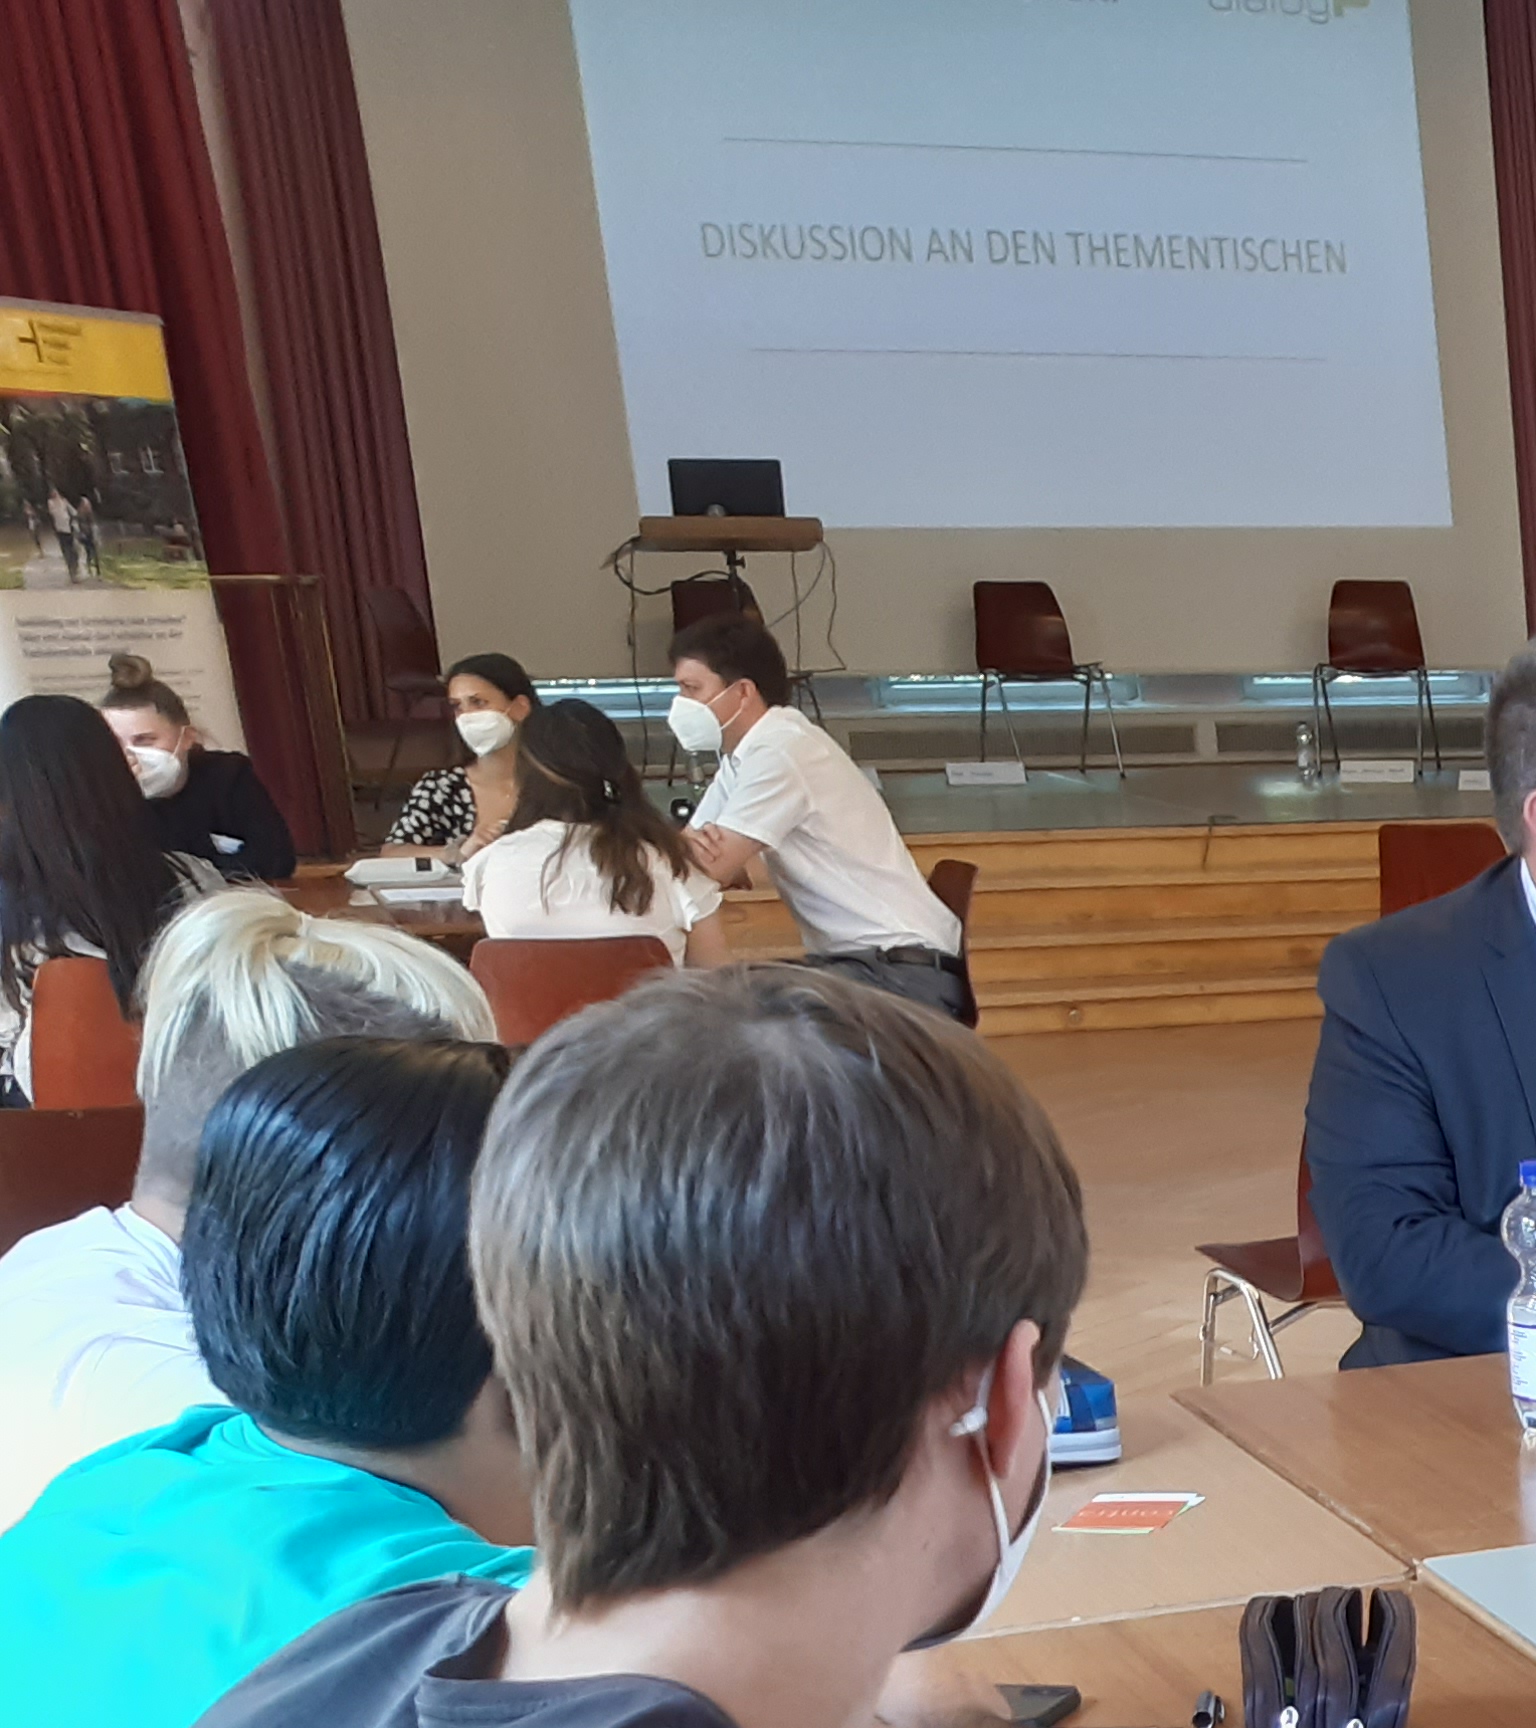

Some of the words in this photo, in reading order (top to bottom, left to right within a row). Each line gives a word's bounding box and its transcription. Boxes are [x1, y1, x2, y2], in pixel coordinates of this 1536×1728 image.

[701, 223, 914, 263] DISKUSSION
[927, 228, 974, 263] AN
[987, 230, 1056, 265] DEN
[1065, 232, 1347, 273] THEMENTISCHEN
